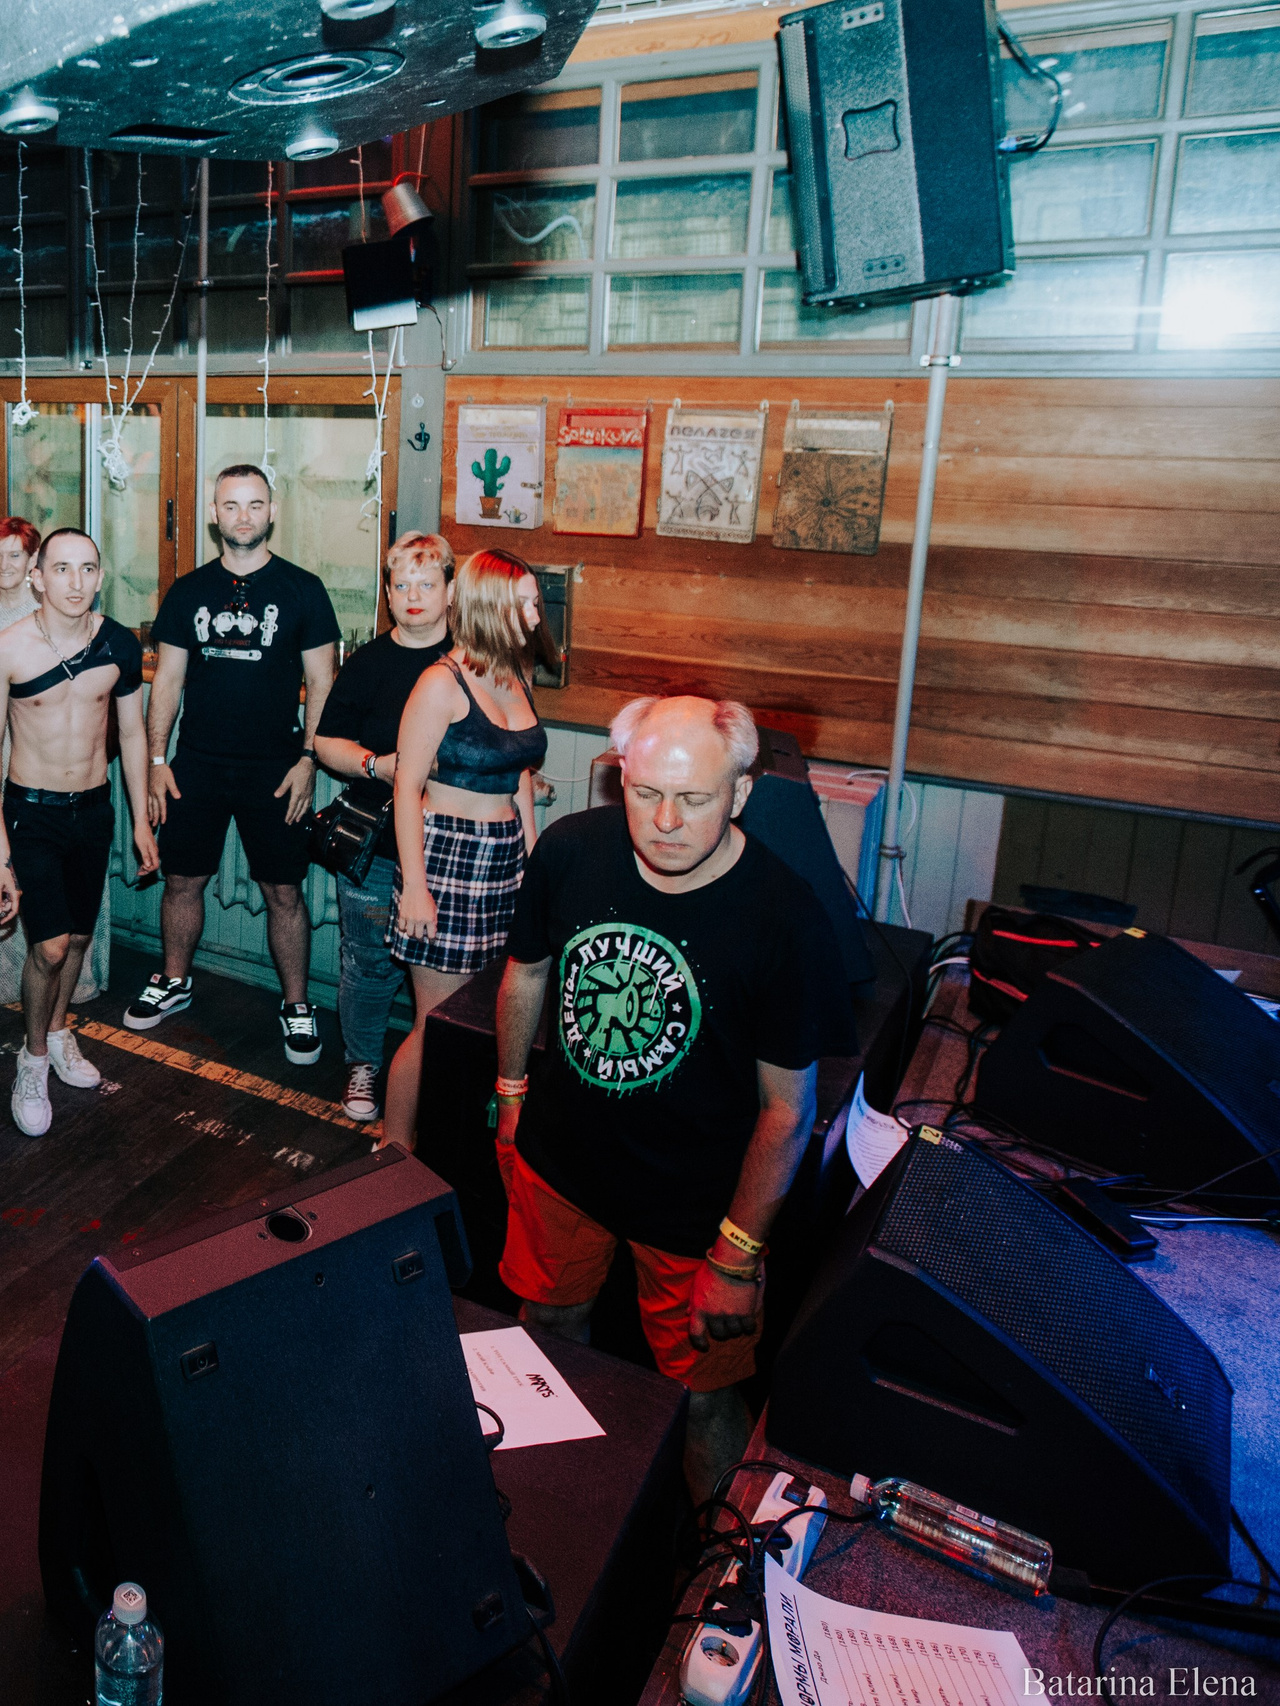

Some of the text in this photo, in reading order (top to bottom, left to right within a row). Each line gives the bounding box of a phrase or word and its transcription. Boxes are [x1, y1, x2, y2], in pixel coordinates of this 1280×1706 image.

[578, 936, 686, 998] ЛУЧШИЙ
[597, 1021, 686, 1080] САМЫЙ
[780, 1591, 804, 1658] МОРАЛИ
